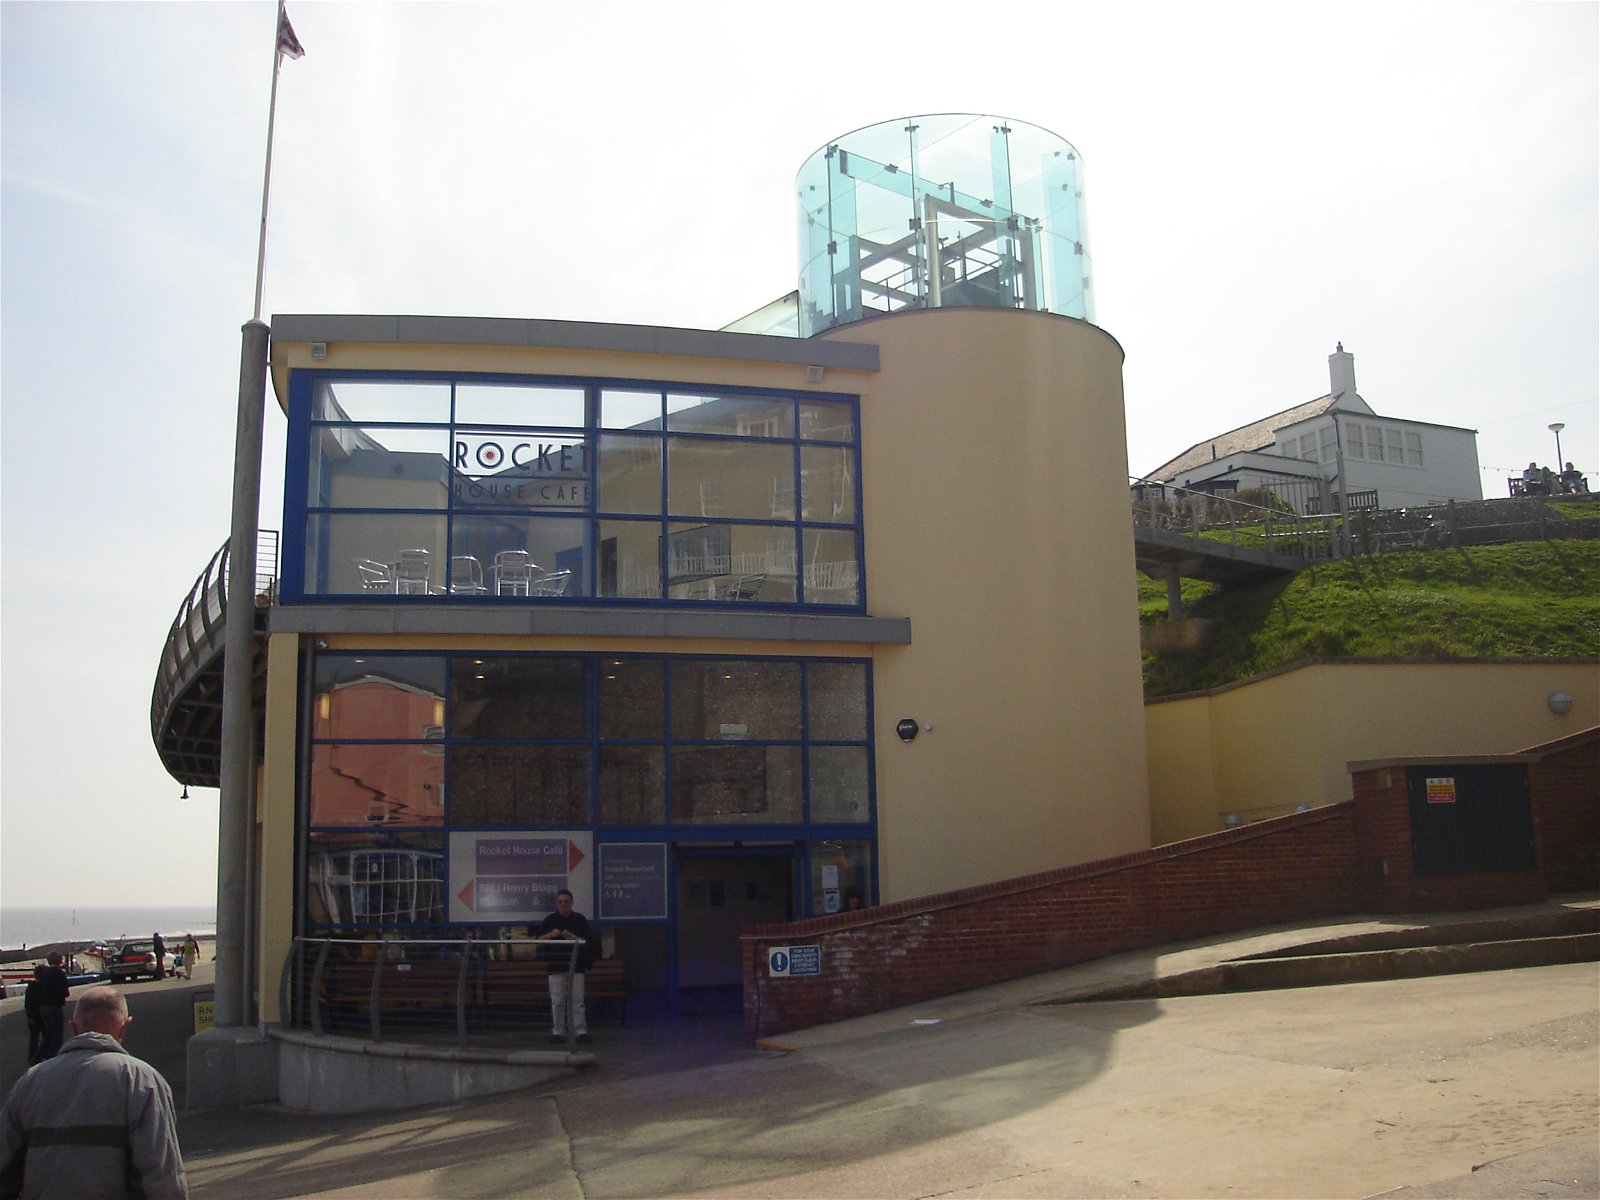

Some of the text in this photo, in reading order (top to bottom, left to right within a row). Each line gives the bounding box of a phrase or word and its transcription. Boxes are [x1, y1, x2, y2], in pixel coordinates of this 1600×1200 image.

[455, 441, 588, 472] ROCKET
[454, 483, 525, 499] HOUSE
[479, 845, 511, 856] Rocket
[513, 845, 541, 856] House
[503, 882, 530, 894] Henry
[531, 882, 558, 894] Blogg
